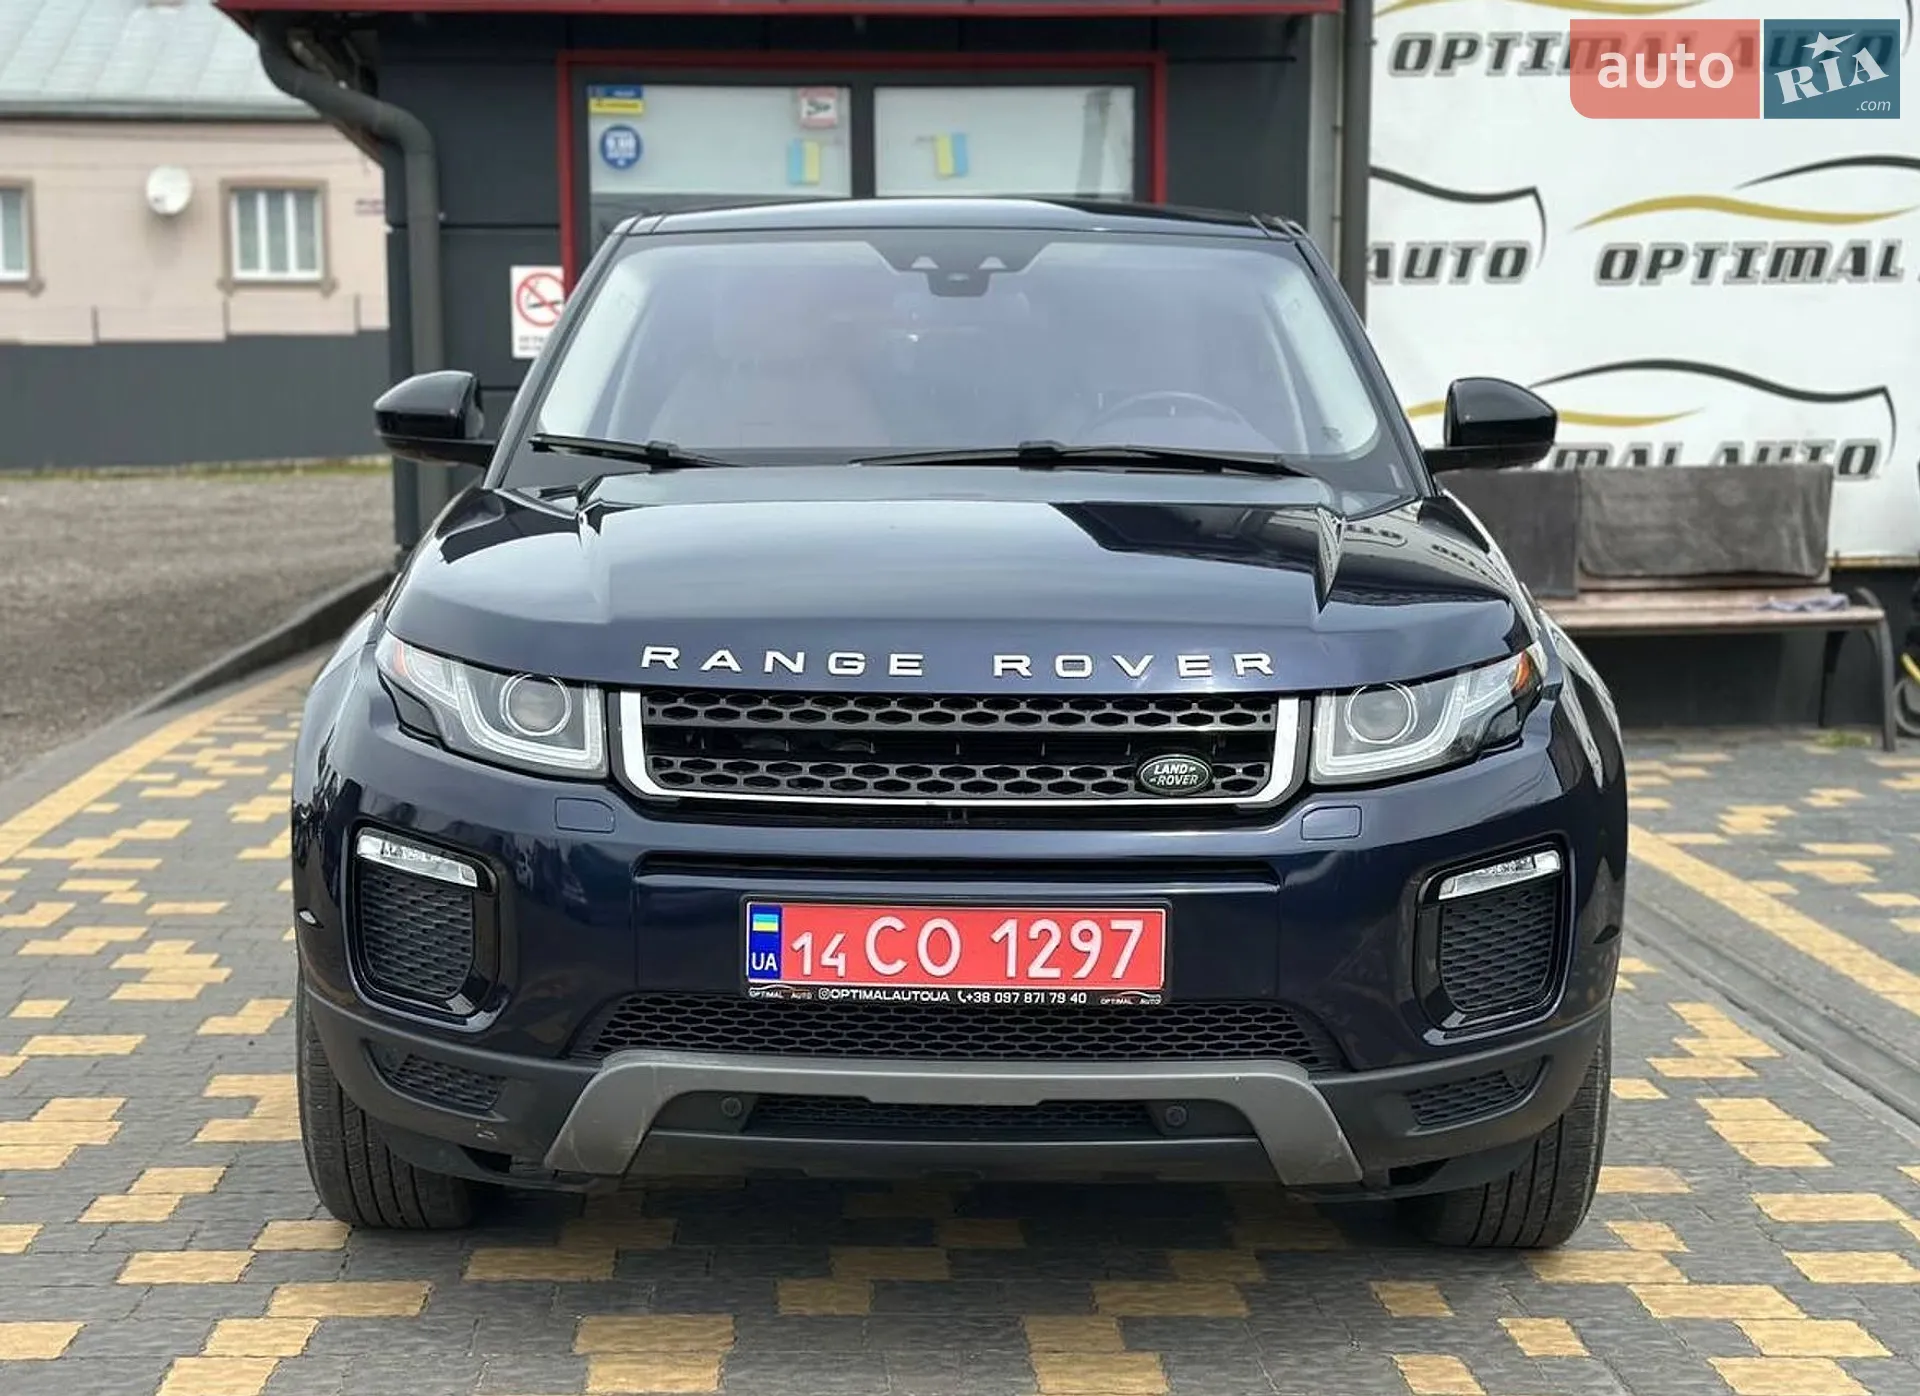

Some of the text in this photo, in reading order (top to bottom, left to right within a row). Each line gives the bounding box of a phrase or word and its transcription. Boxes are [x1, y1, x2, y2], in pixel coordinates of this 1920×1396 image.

[1594, 239, 1905, 287] OPTIMAL
[640, 645, 1275, 678] RANGE ROVER
[1153, 763, 1188, 775] LAND
[1156, 774, 1199, 786] ROVER
[791, 916, 1145, 980] 14 CO 1297
[751, 951, 778, 971] UA
[966, 991, 990, 1004] +38
[994, 992, 1019, 1004] 097
[1024, 992, 1045, 1004] 871
[1050, 992, 1066, 1005] 79
[1070, 992, 1087, 1005] 40
